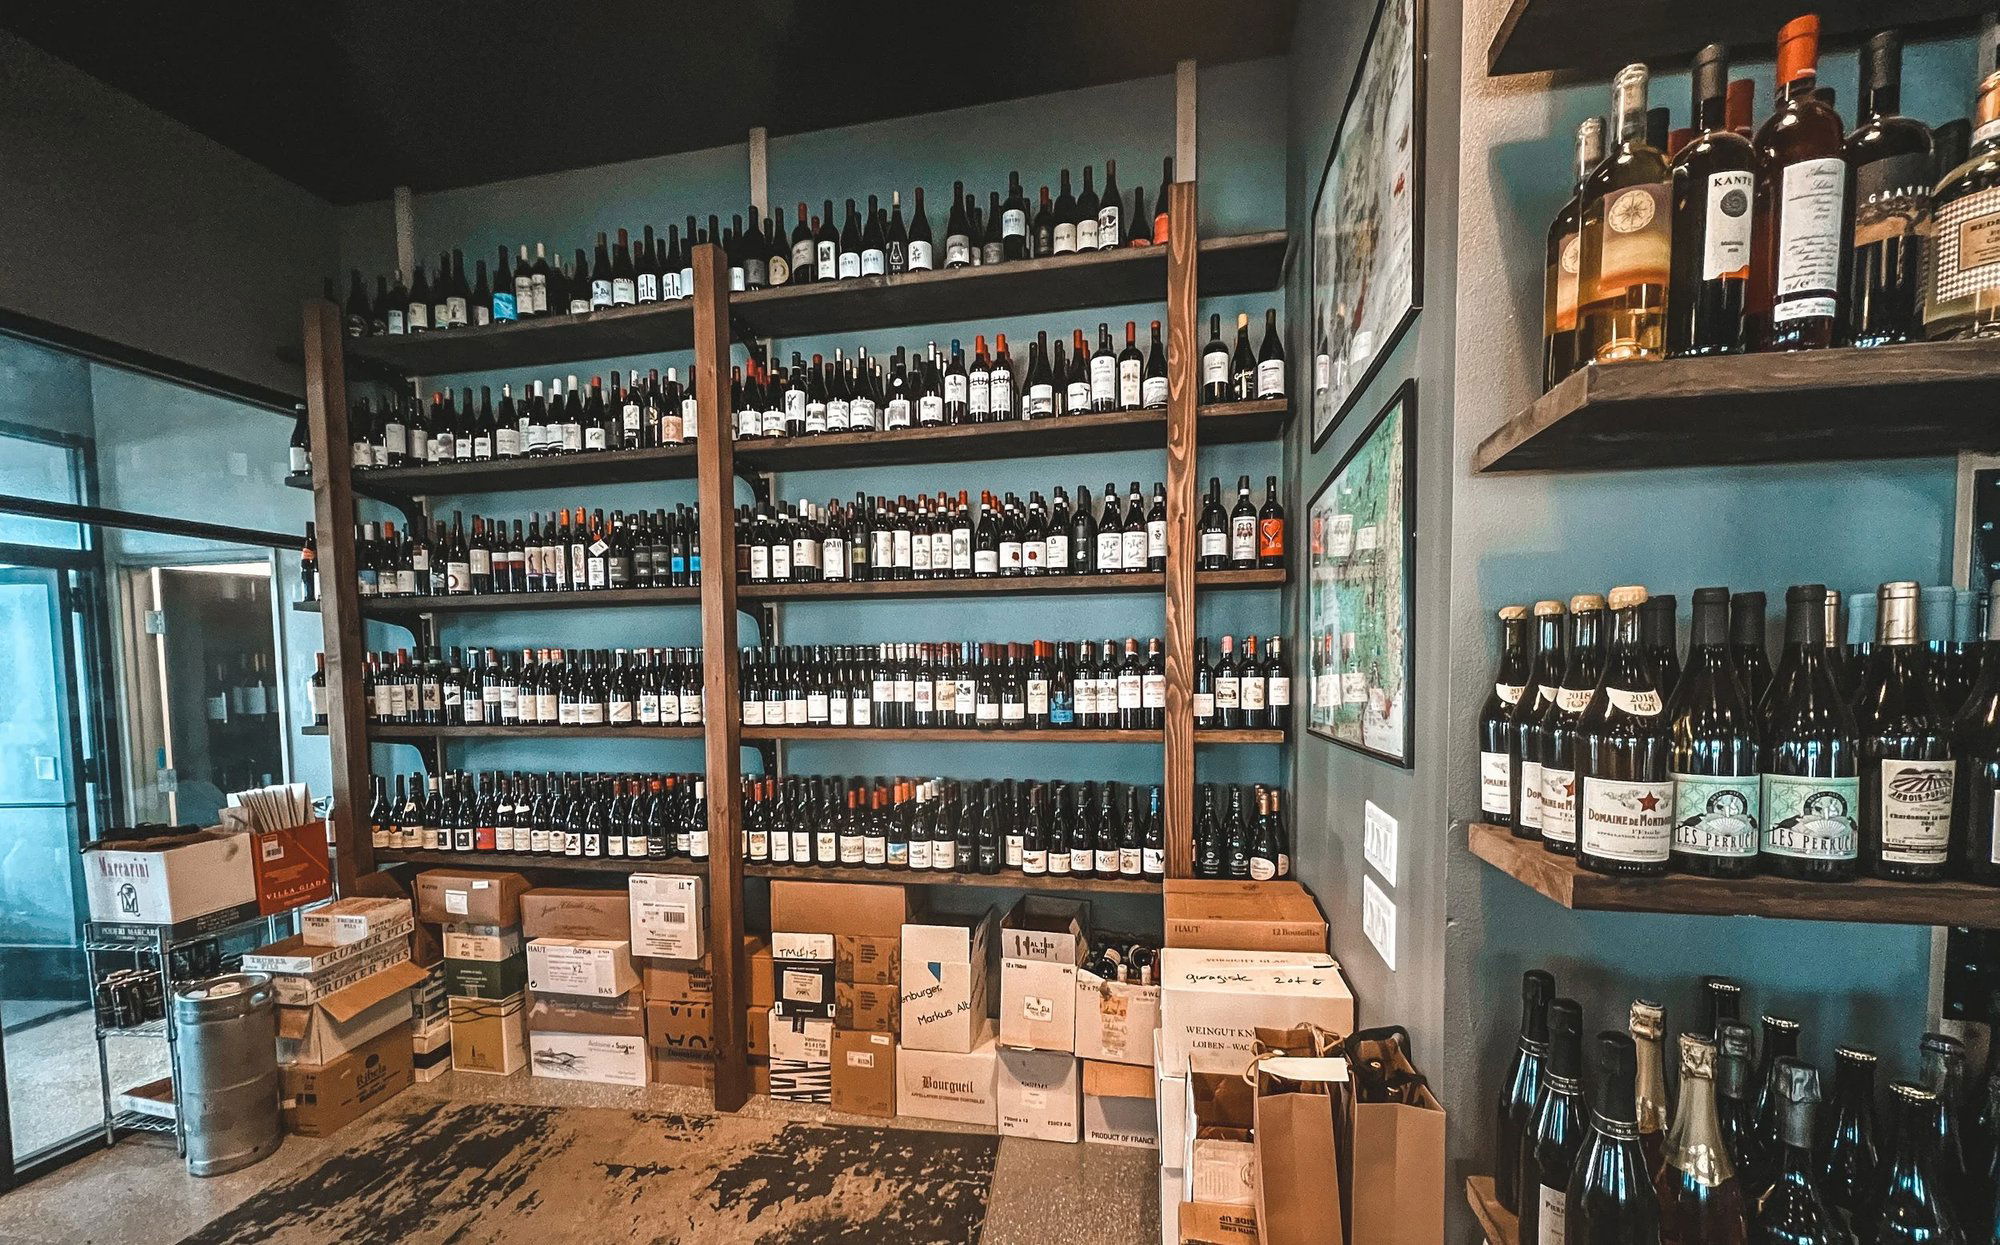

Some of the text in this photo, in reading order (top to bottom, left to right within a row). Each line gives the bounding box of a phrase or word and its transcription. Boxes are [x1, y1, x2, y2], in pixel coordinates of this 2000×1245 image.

[1868, 184, 1931, 204] GRAVN
[1630, 694, 1655, 703] 2018
[1588, 807, 1627, 825] DOMAINE
[1629, 818, 1638, 826] DE
[1676, 825, 1698, 844] LES
[1771, 827, 1794, 846] LES
[98, 857, 150, 878] Marcarini
[266, 878, 327, 900] VILLA GIADA
[128, 928, 158, 937] MARCAR
[1174, 926, 1201, 934] HAUT
[1282, 929, 1320, 937] Bouteilles
[316, 920, 413, 968] TRUMER PILS
[528, 945, 546, 954] HAUT
[250, 957, 287, 965] TRUMER
[311, 949, 409, 1000] TRUMER PILS
[598, 987, 613, 995] BAS
[917, 1008, 953, 1026] Markus
[1185, 1025, 1236, 1037] WEINGUT
[1192, 1040, 1250, 1051] LOIBEN WAC
[921, 1075, 974, 1094] Bourgueil
[1091, 1131, 1155, 1145] PRODUCT OF FRANCE
